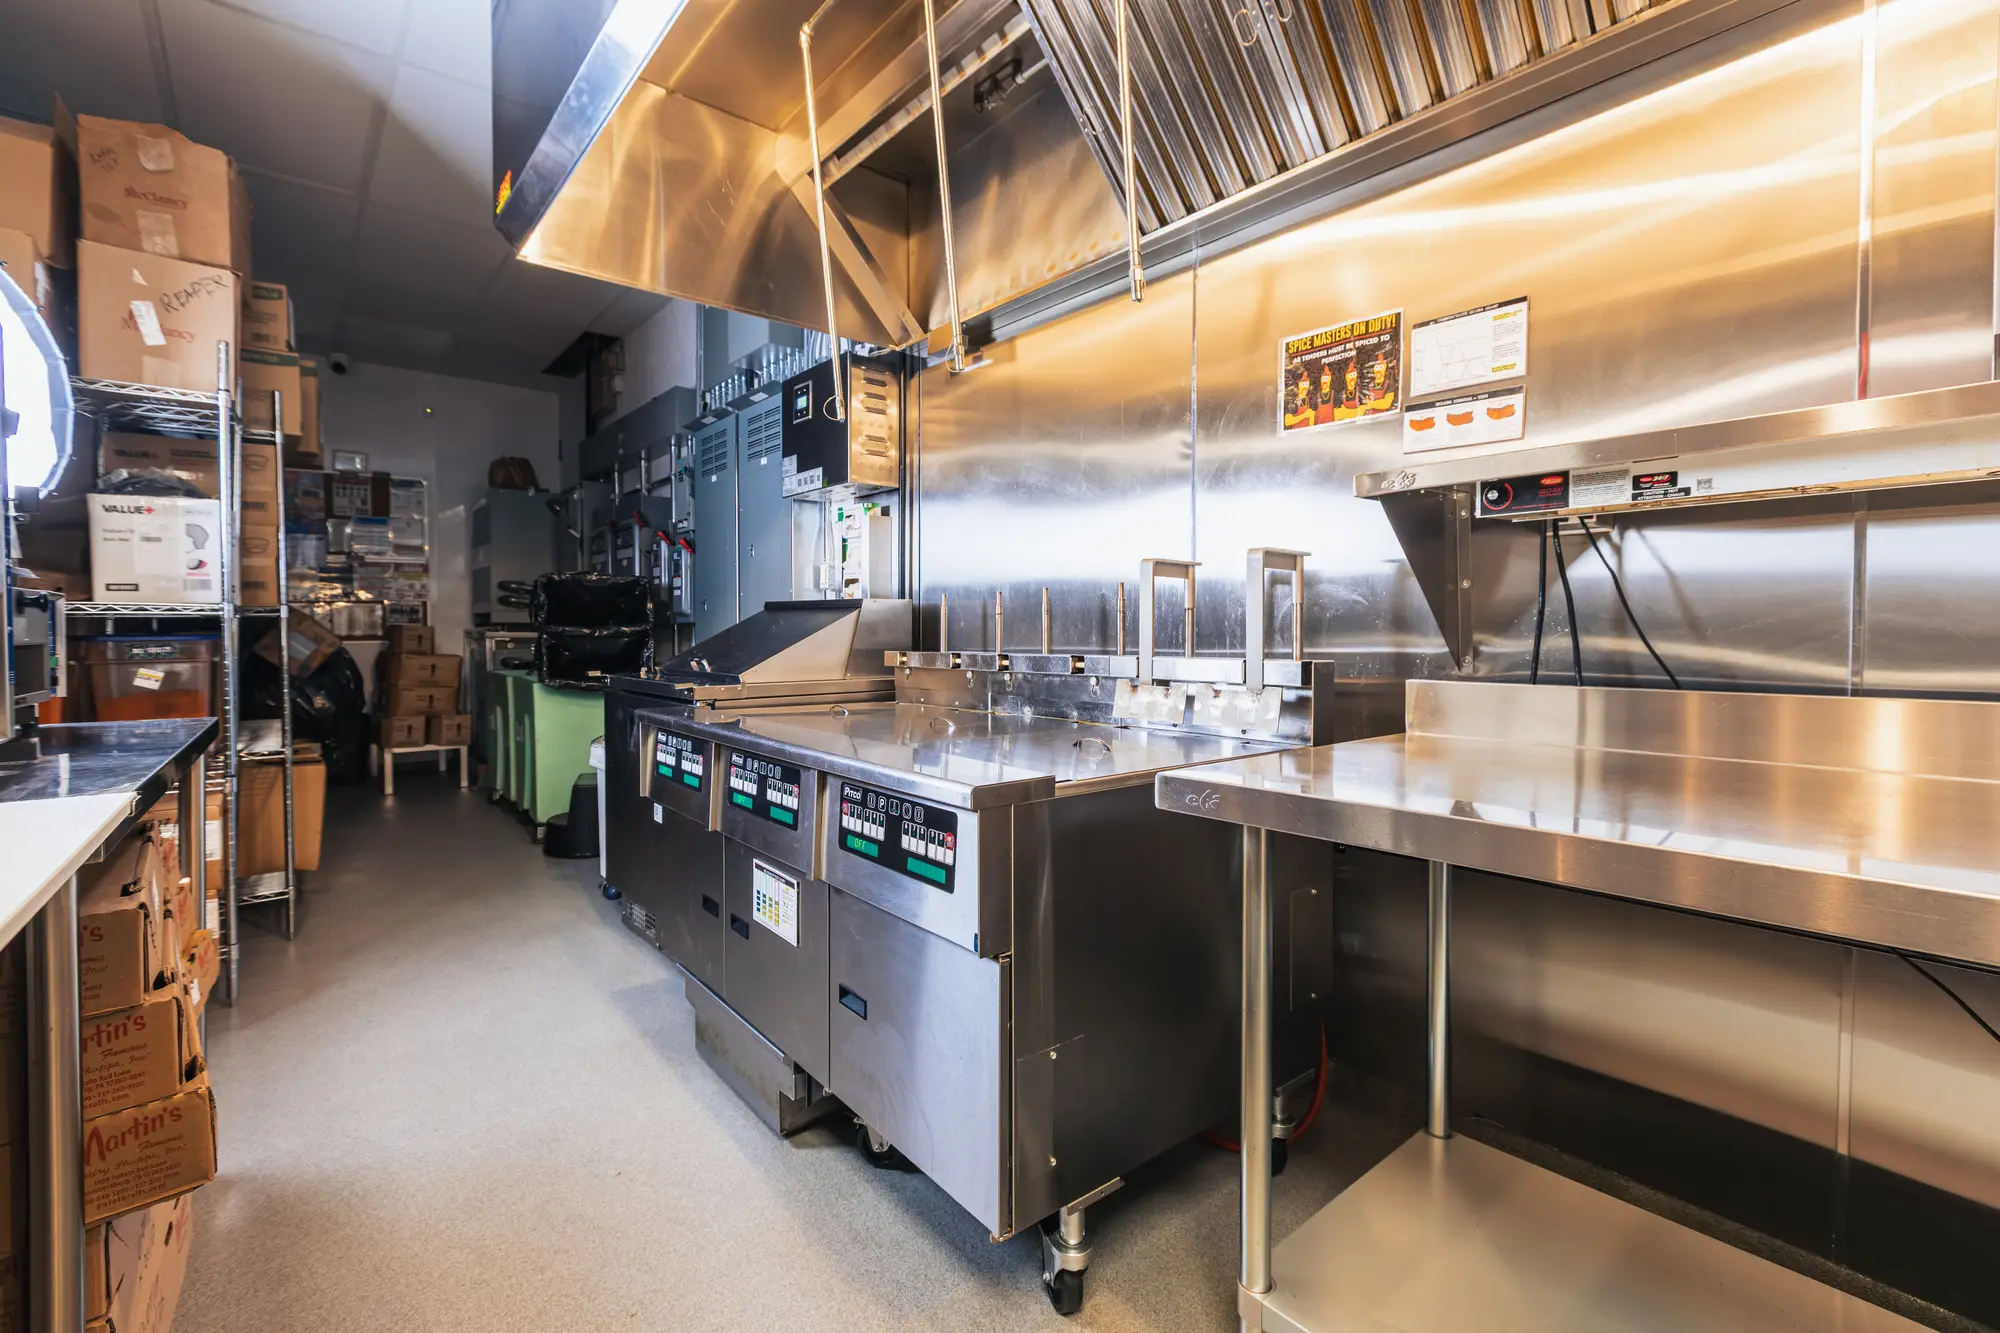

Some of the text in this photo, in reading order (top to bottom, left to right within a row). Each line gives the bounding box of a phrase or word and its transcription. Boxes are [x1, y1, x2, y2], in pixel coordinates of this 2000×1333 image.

[1288, 314, 1396, 354] SPICE MASTERS ON DUTY!
[1302, 350, 1327, 362] TENDERS
[1328, 345, 1345, 355] MUST
[1355, 336, 1379, 348] SPICED
[1380, 334, 1391, 343] TO
[1321, 350, 1356, 364] PERFECTION
[854, 838, 866, 849] OFF
[82, 1015, 146, 1054] rtin's
[85, 1061, 124, 1074] hoppe,
